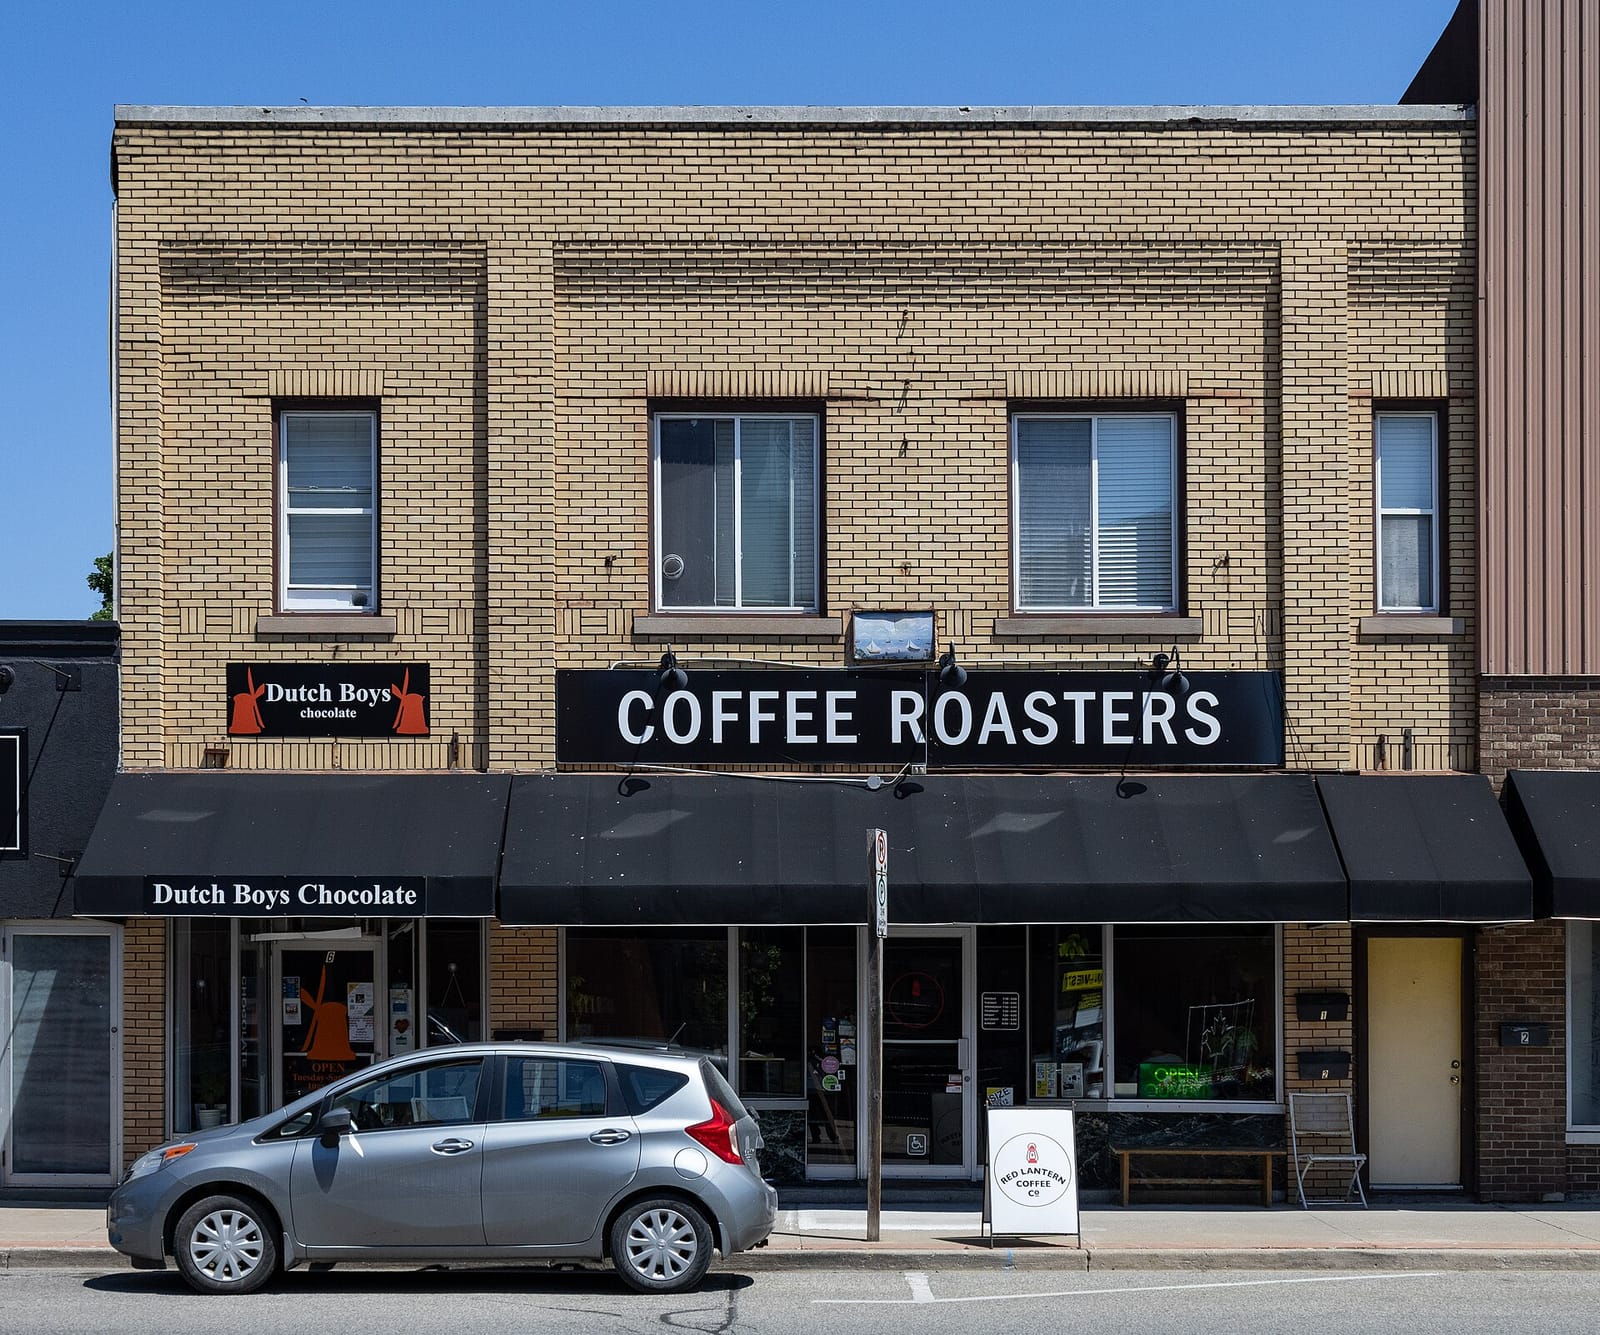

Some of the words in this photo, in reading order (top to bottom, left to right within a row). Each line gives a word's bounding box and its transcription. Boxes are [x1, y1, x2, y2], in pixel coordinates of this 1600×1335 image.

[266, 683, 332, 702] Dutch
[339, 683, 391, 707] Boys
[300, 707, 357, 719] chocolate
[618, 690, 858, 745] COFFEE
[890, 690, 1222, 745] ROASTERS
[152, 883, 226, 905] Dutch
[233, 883, 290, 910] Boys
[297, 883, 417, 905] Chocolate
[311, 1063, 345, 1072] OPEN
[989, 1087, 1010, 1102] SIZE
[1000, 1170, 1019, 1185] RED
[1020, 1167, 1067, 1185] LANTERN
